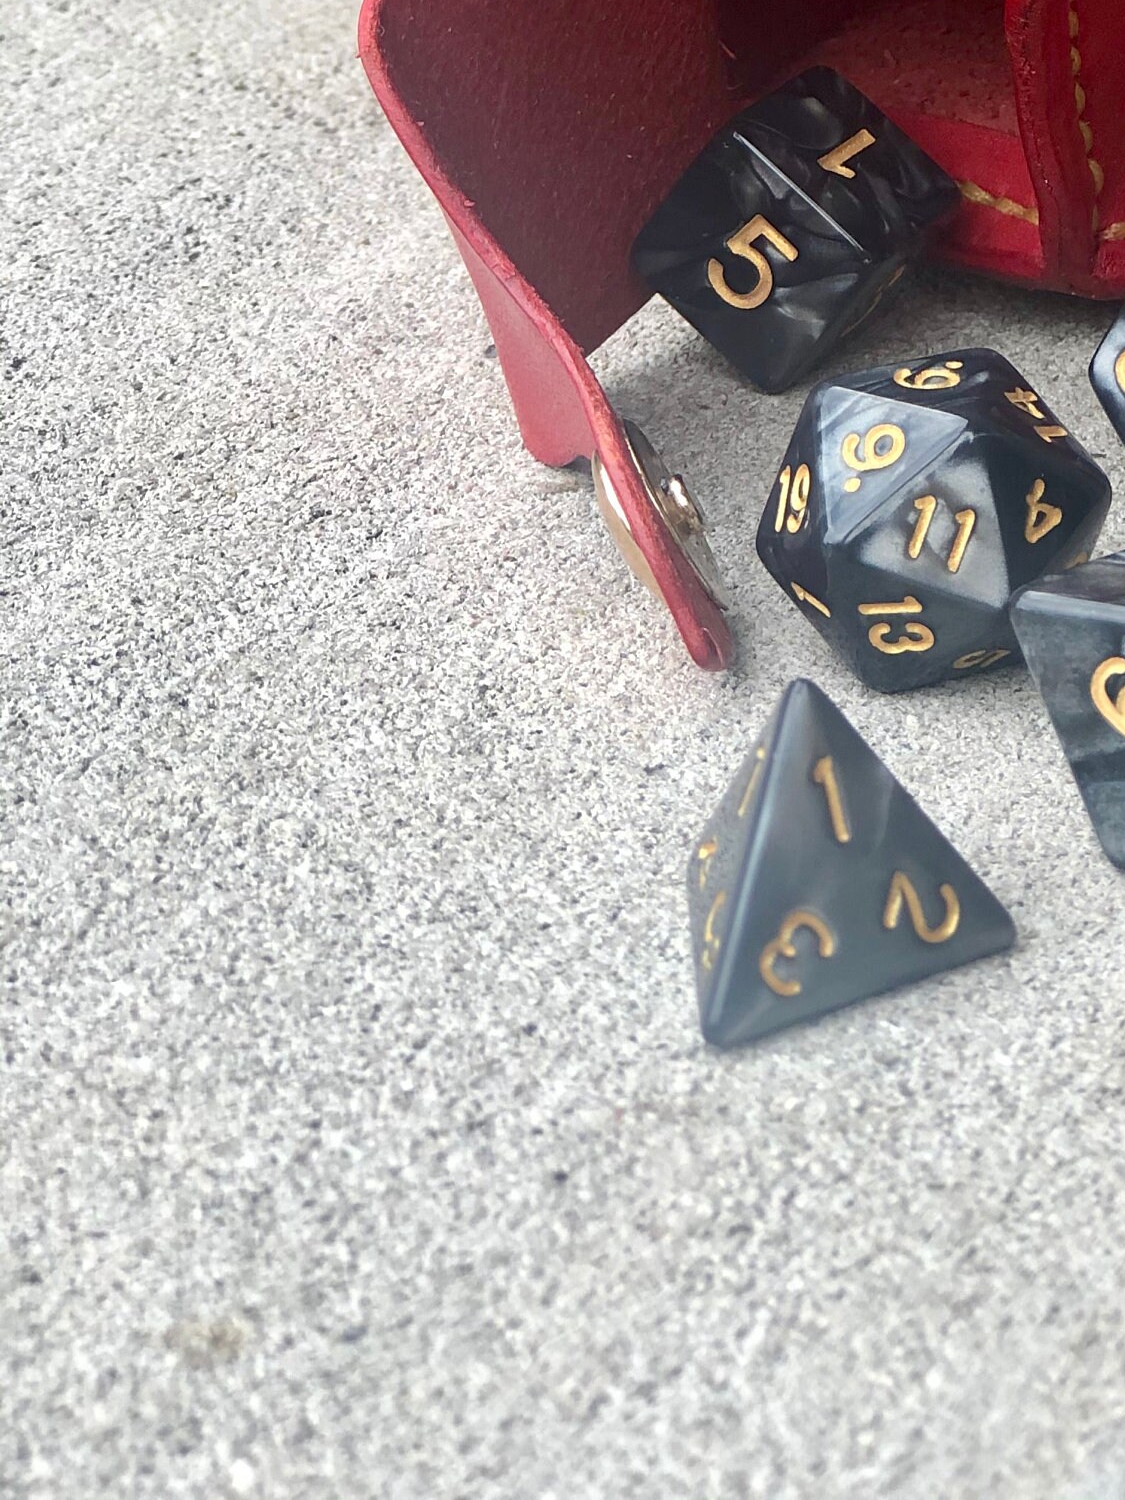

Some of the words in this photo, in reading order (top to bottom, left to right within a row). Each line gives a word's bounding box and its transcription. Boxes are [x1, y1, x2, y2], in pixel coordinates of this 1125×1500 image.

[707, 214, 798, 309] 5
[775, 463, 811, 534] 19
[913, 494, 976, 574] 11
[1023, 478, 1062, 544] 4
[858, 595, 935, 654] 13
[813, 754, 851, 843] 1
[884, 870, 961, 943] 2
[759, 910, 835, 996] 3
